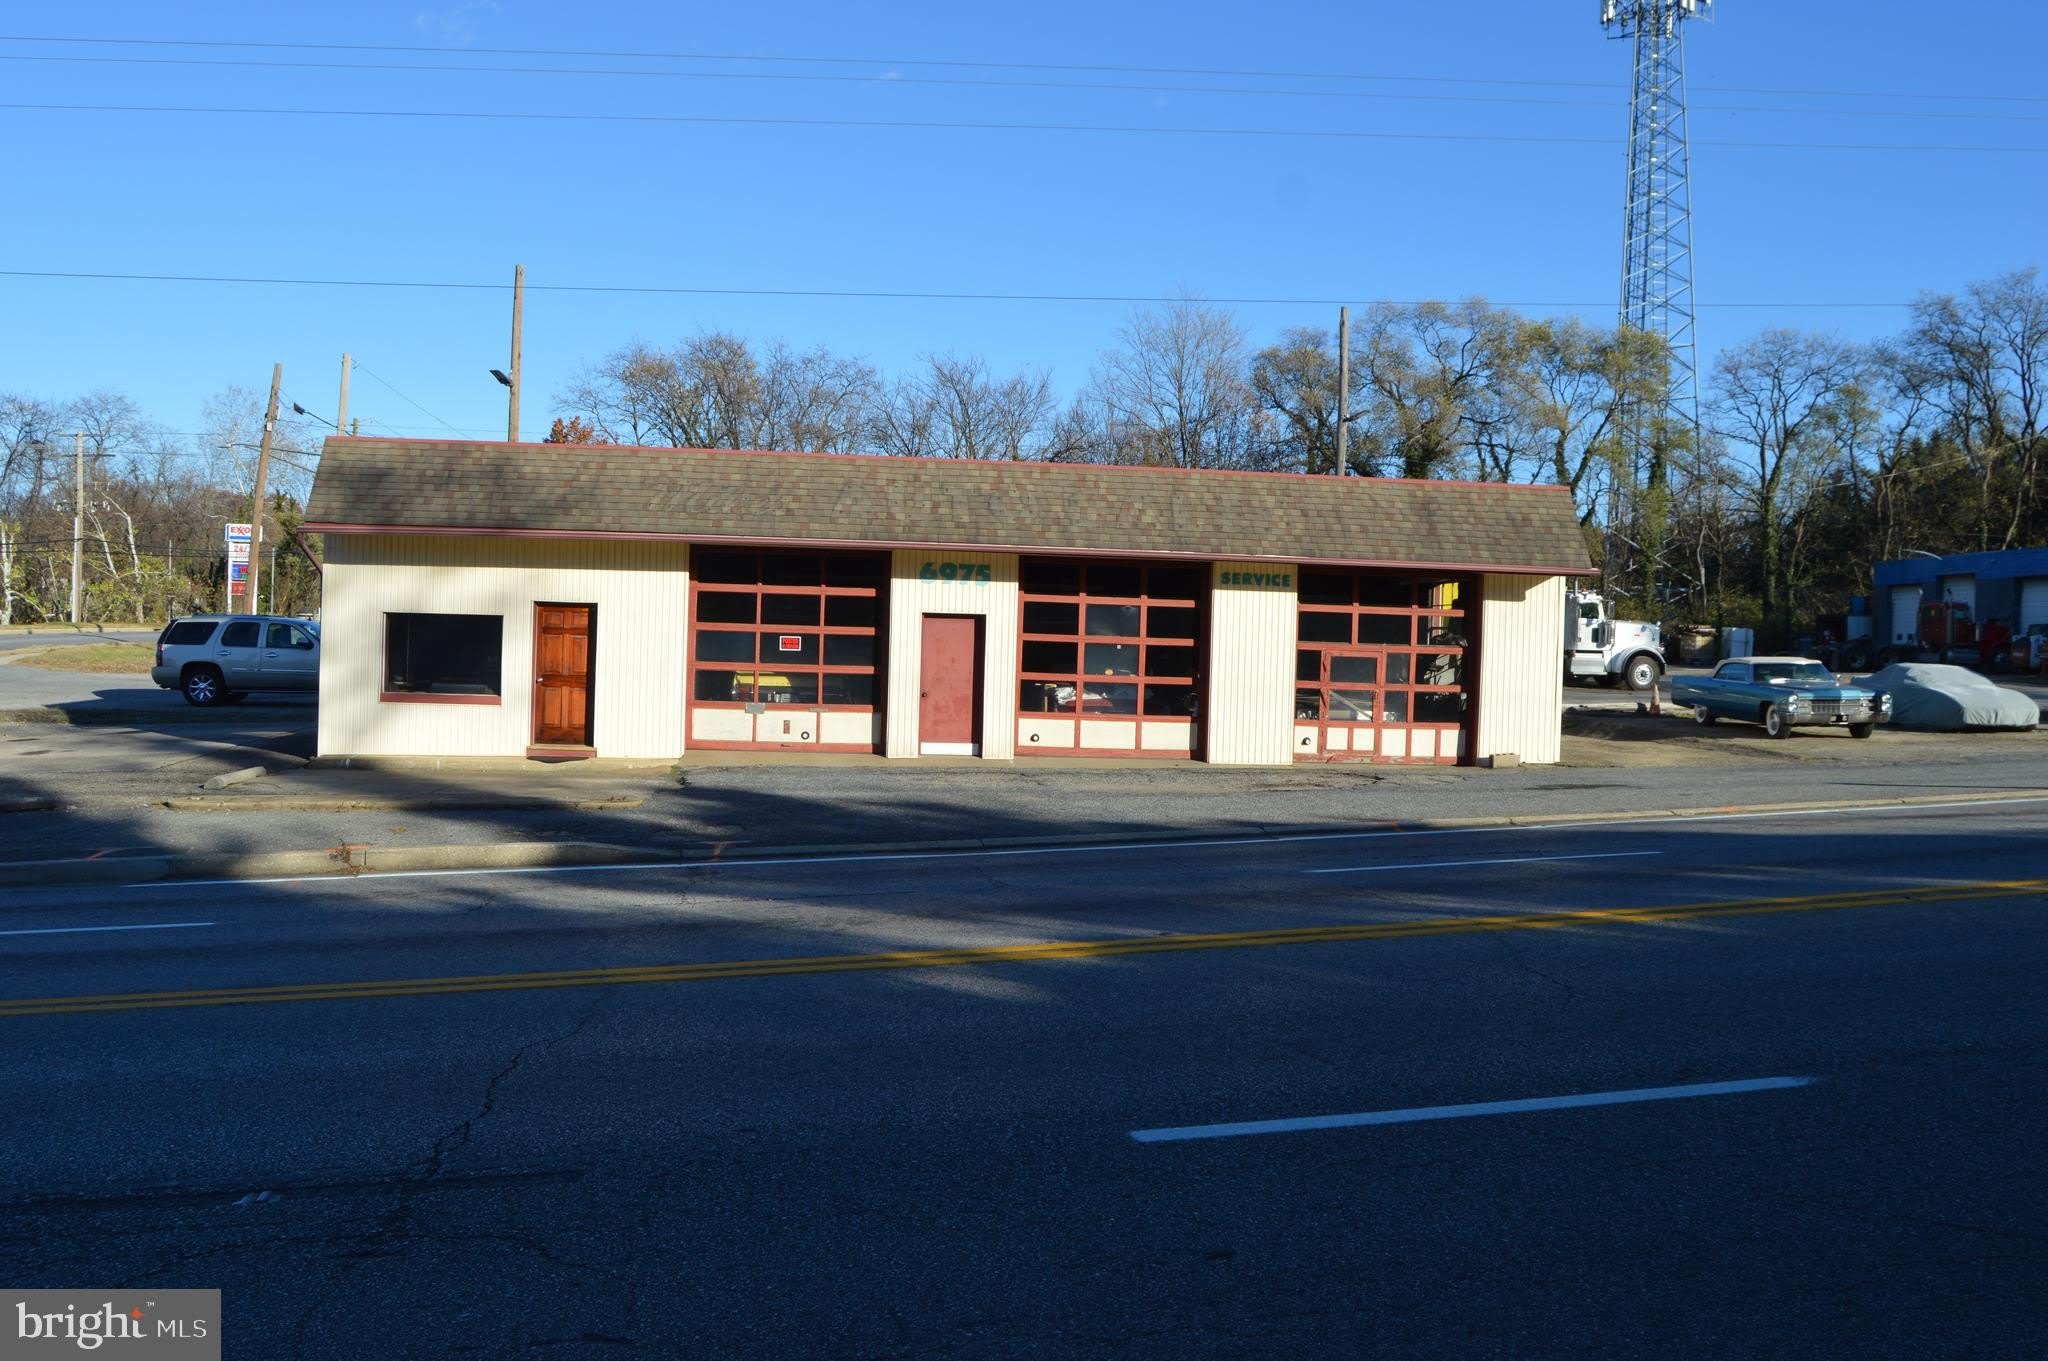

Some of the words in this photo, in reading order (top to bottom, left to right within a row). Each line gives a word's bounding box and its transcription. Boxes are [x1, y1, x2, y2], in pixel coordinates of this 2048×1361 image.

[230, 526, 251, 536] EXXO
[919, 561, 991, 586] 6975
[1221, 572, 1291, 587] SERVICE
